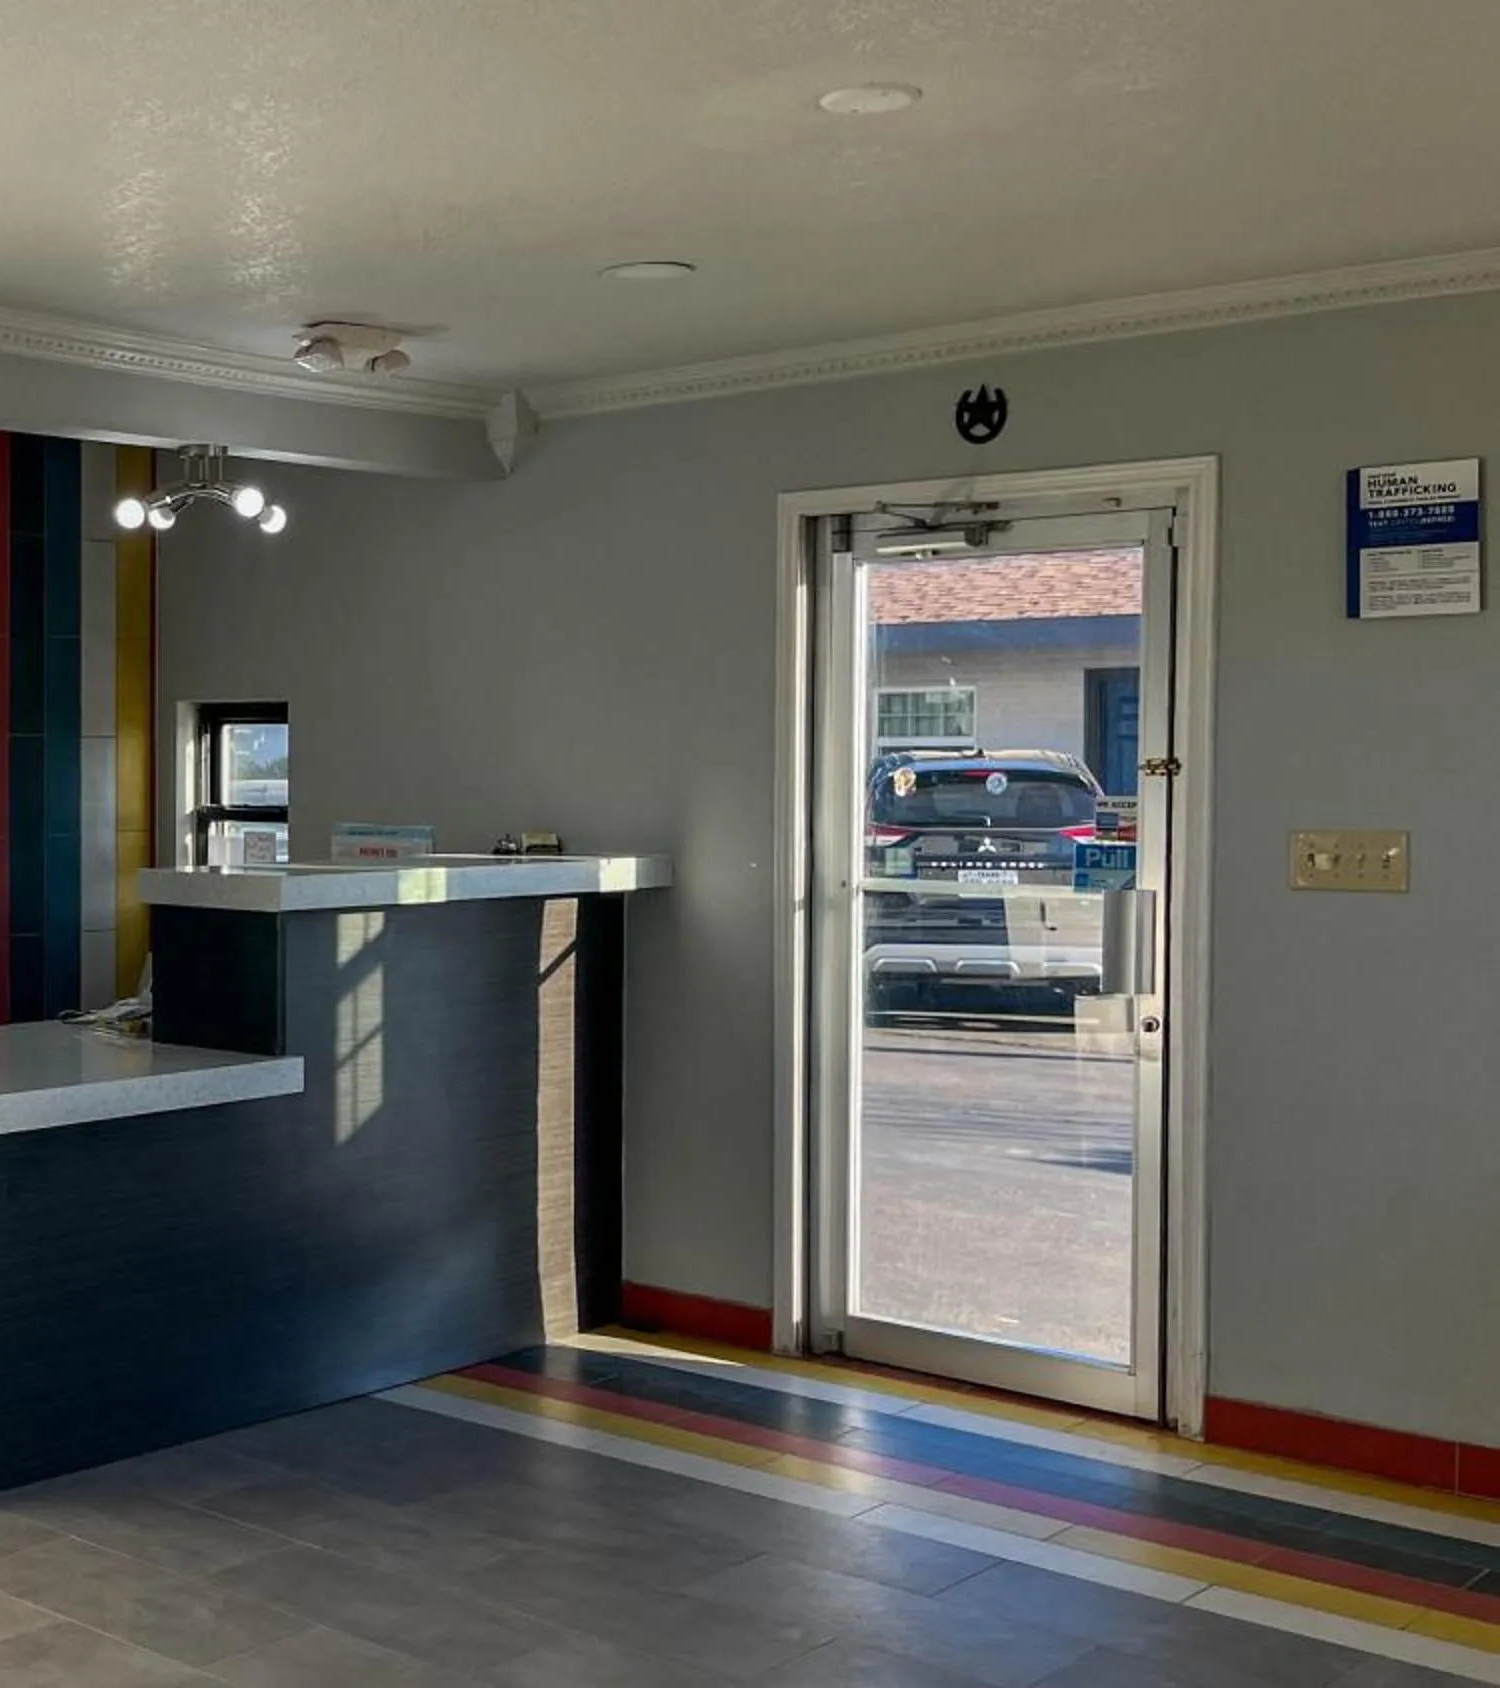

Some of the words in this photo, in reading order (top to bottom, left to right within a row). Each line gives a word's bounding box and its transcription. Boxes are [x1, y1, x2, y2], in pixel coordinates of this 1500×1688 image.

[1367, 475, 1418, 489] HUMAN
[1368, 482, 1457, 498] TRAFFICKING
[1085, 848, 1129, 869] Pull
